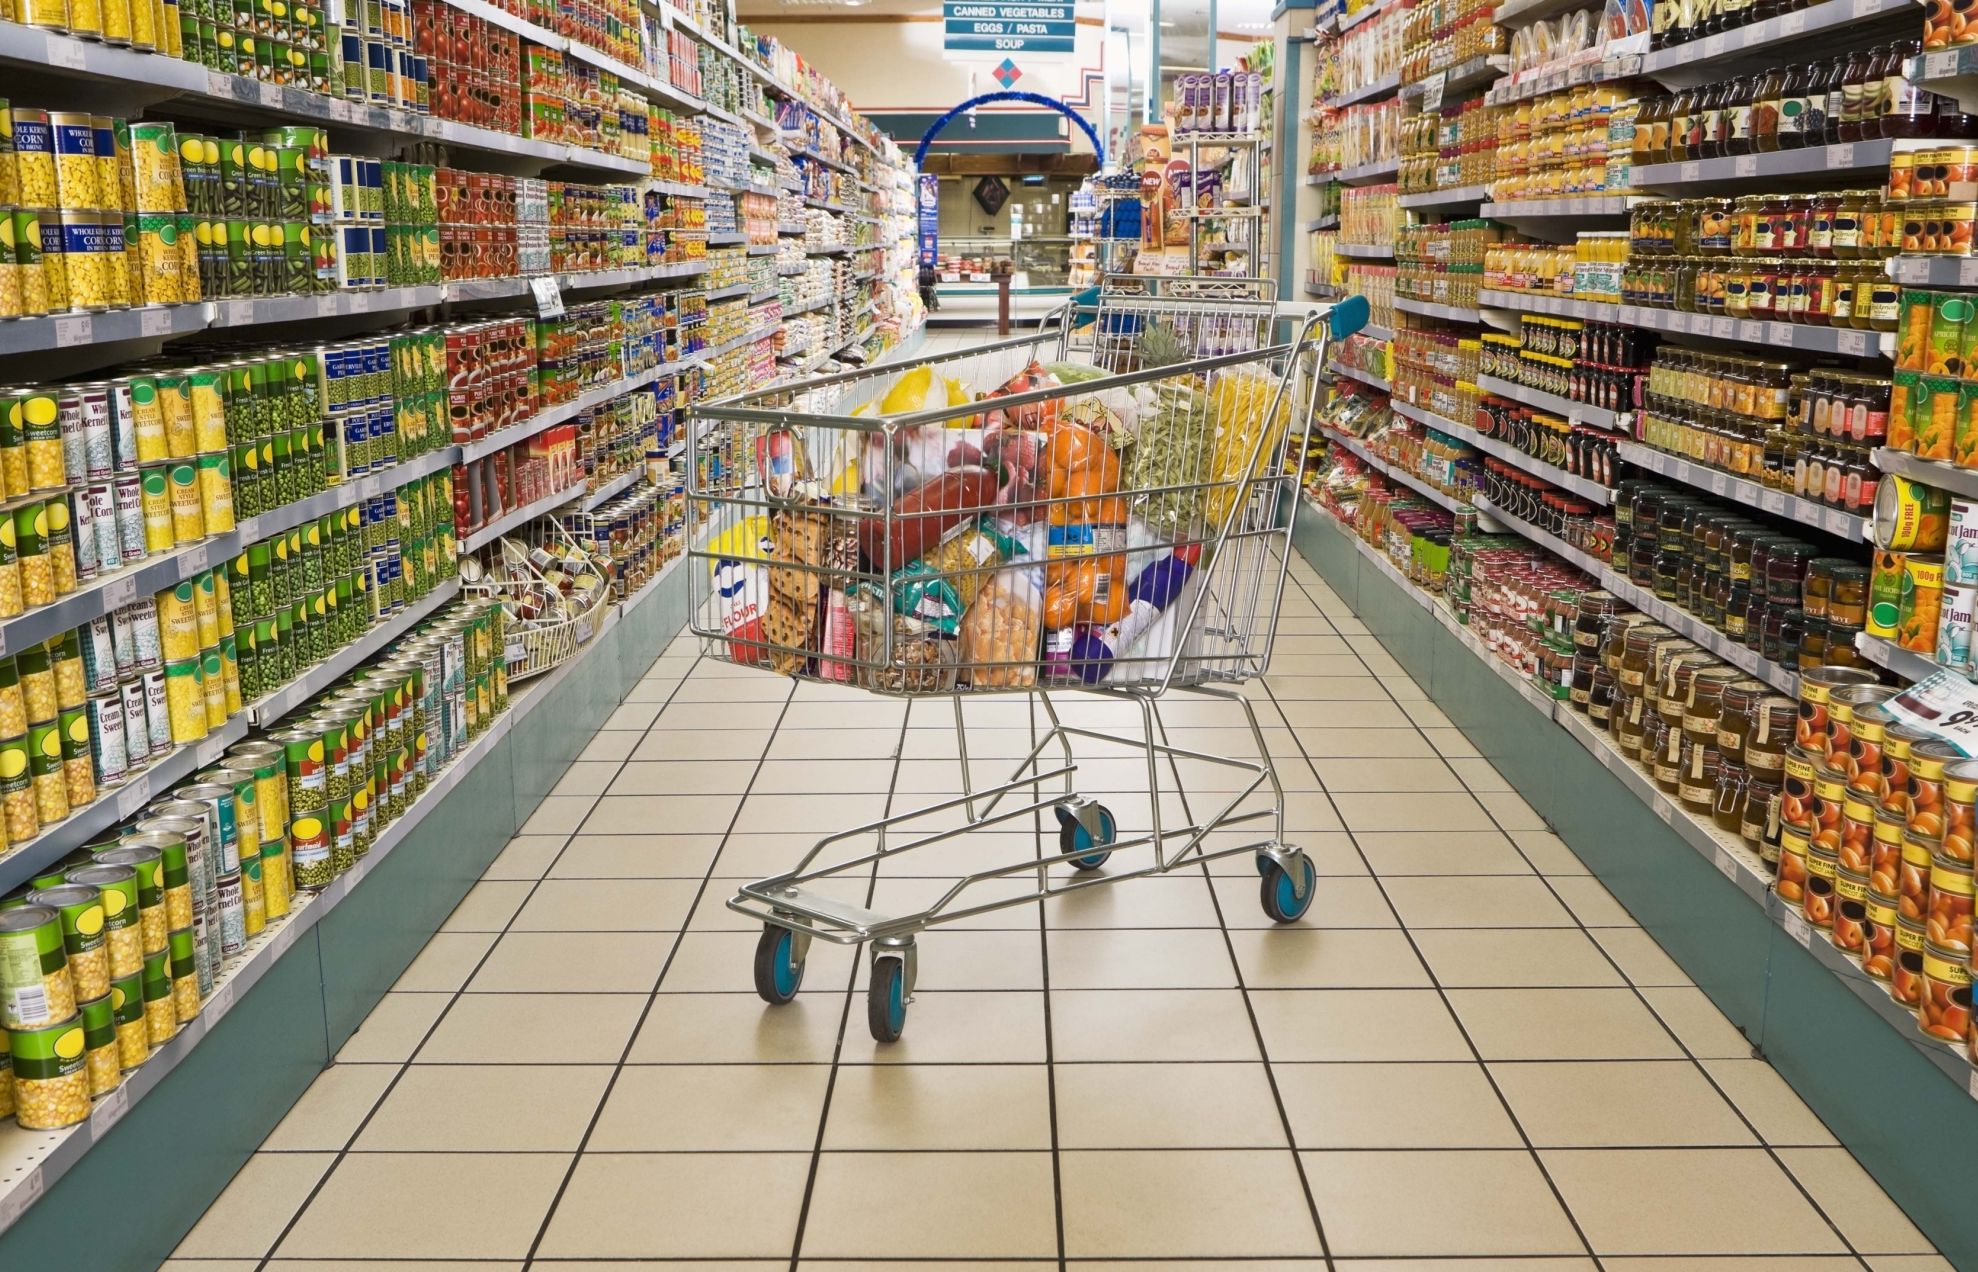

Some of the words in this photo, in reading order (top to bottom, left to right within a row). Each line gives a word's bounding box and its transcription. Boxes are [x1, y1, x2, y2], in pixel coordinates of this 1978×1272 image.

[953, 6, 997, 17] CANNED
[1000, 6, 1065, 19] VEGETABLES
[973, 22, 1004, 34] EGGS
[1006, 23, 1014, 34] /
[1016, 23, 1048, 35] PASTA
[995, 38, 1025, 50] SOUP
[14, 134, 44, 144] CORN
[1142, 177, 1160, 186] NEW
[1904, 503, 1914, 520] FREE
[1901, 520, 1913, 539] 100g
[1917, 570, 1935, 583] 100g
[723, 603, 758, 629] FLOUR
[1949, 608, 1971, 624] Jam
[1797, 764, 1811, 773] FINE
[1808, 857, 1823, 868] SUPER
[1822, 863, 1837, 871] FINE
[1839, 879, 1857, 891] SUPER
[218, 885, 240, 899] Whole
[1899, 931, 1916, 942] SUPER
